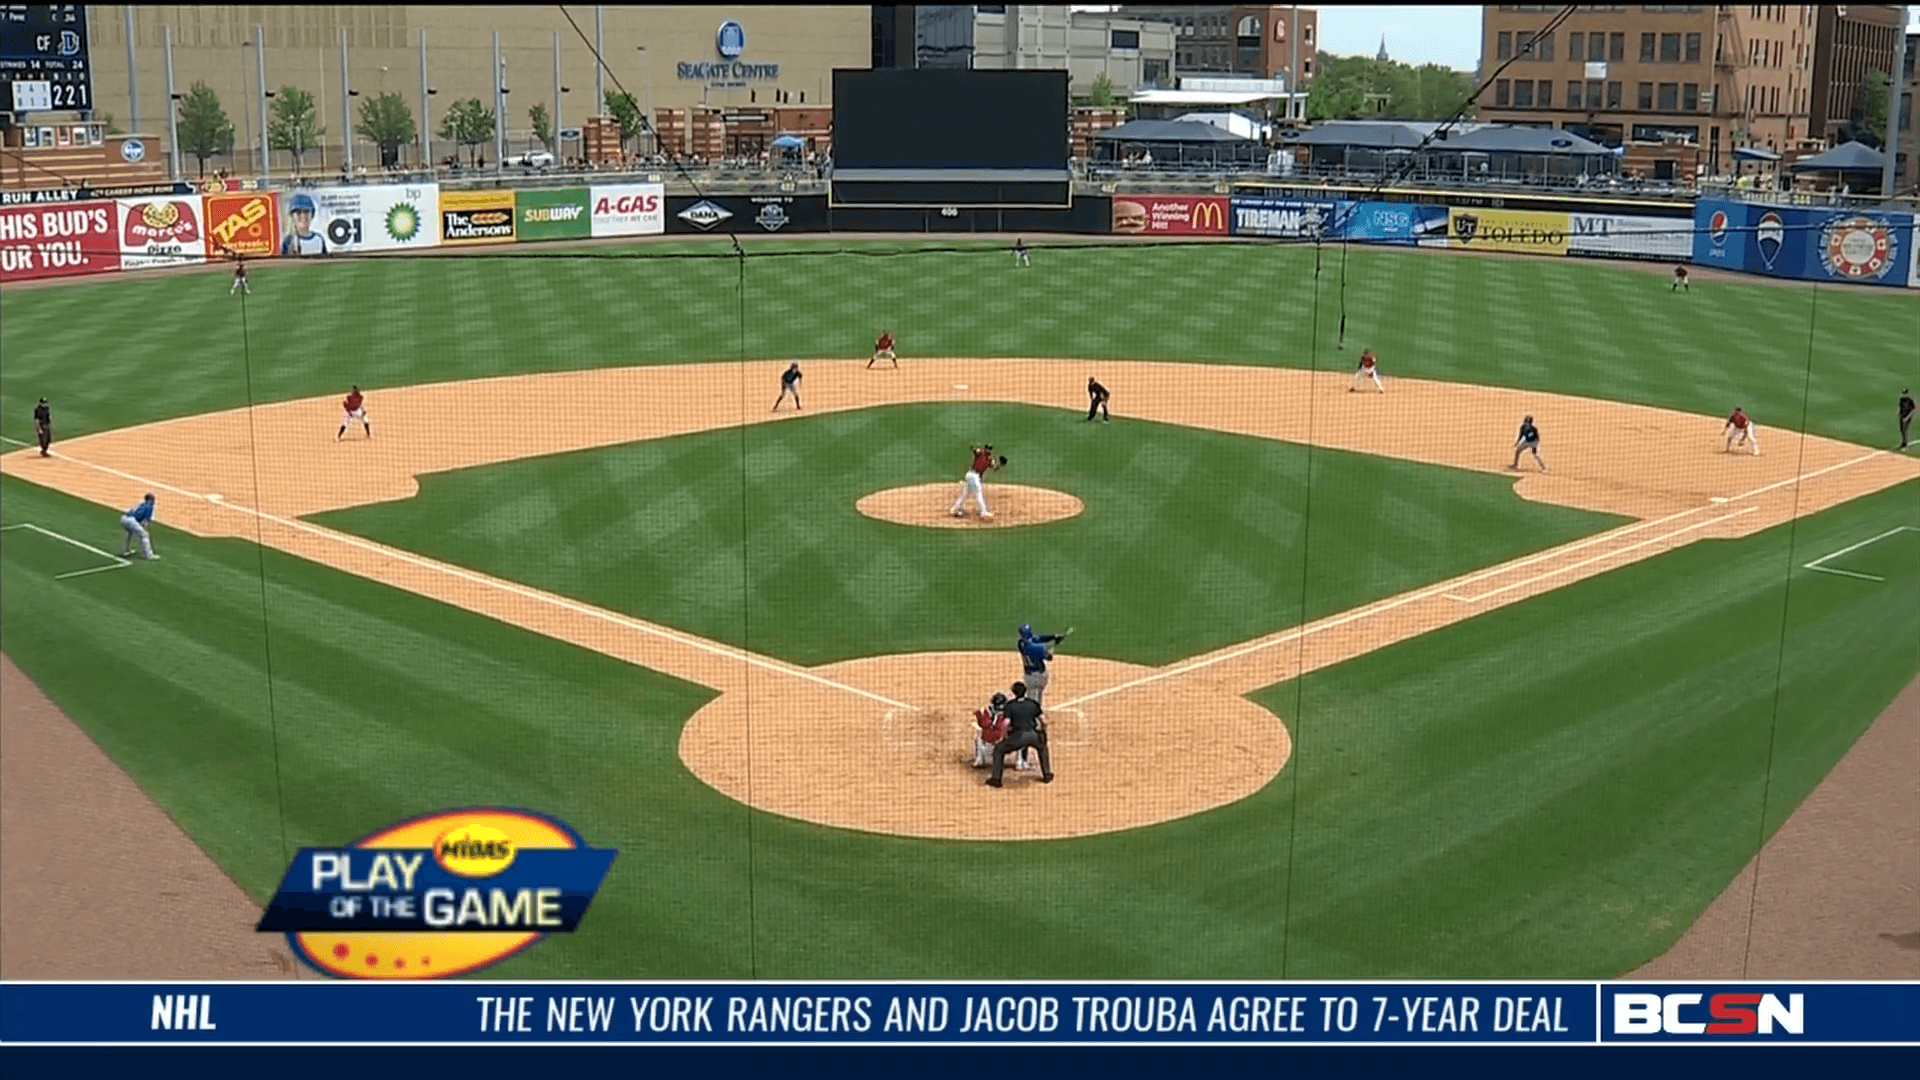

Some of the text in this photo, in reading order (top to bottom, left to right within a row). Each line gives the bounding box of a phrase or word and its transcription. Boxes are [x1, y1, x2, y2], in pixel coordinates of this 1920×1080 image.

[37, 35, 51, 51] CF
[3, 190, 78, 203] RUN ALLEY
[524, 206, 583, 222] SUBWAY
[690, 211, 718, 219] DANA
[1152, 202, 1189, 212] Another
[42, 209, 108, 237] BUD'S
[213, 199, 266, 242] TAS
[446, 213, 469, 225] The
[1152, 211, 1190, 221] Winning
[1236, 208, 1300, 230] TIREMAN
[1573, 207, 1614, 235] MT
[446, 224, 512, 237] Andersons
[1457, 219, 1474, 233] UT
[1480, 226, 1563, 246] TOLEDO
[37, 241, 89, 268] YOU.
